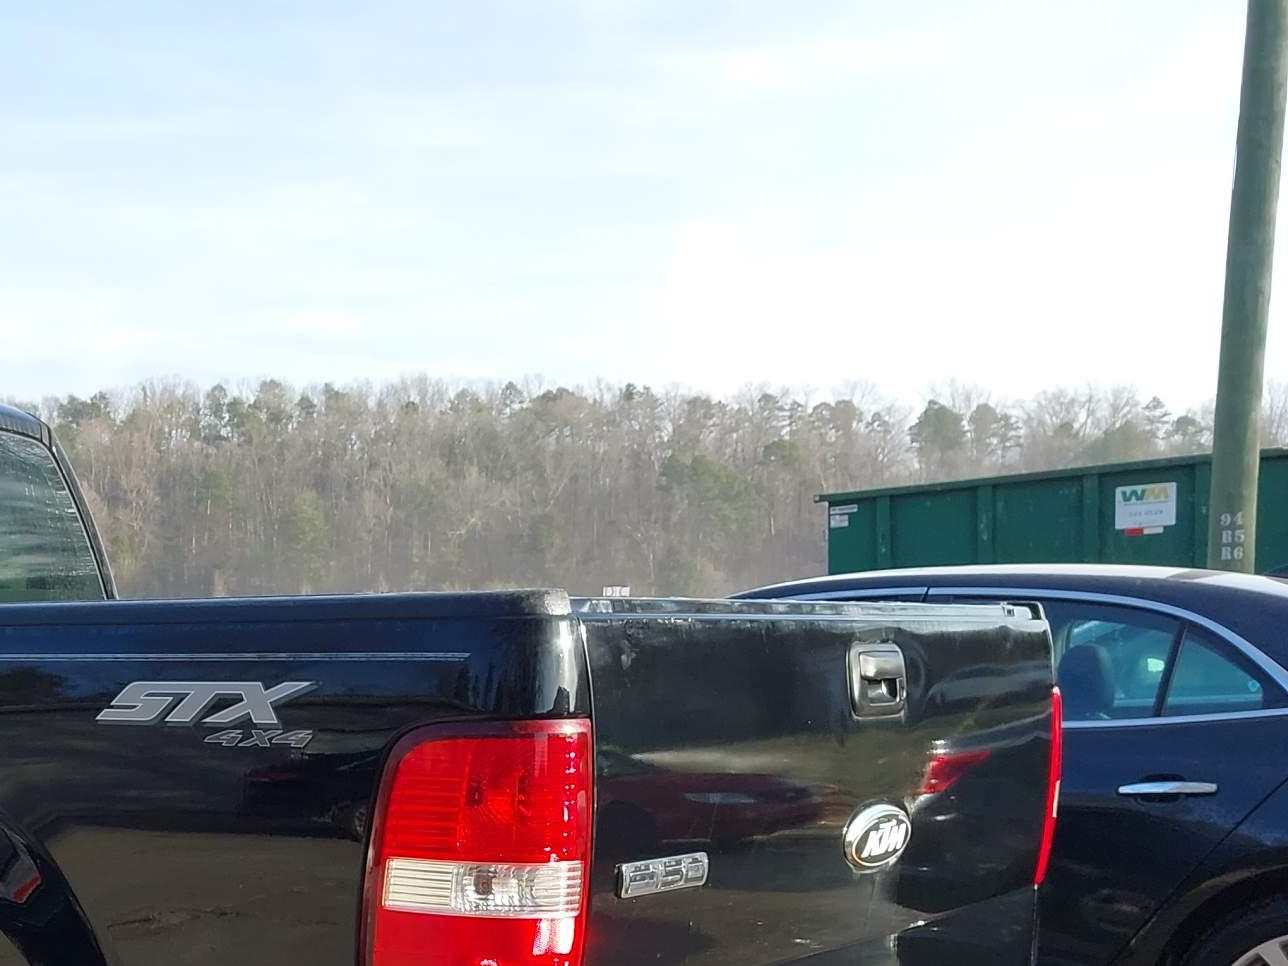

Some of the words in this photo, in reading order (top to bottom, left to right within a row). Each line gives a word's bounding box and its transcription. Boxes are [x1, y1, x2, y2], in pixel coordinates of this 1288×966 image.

[1121, 487, 1168, 502] WM
[1220, 512, 1243, 527] 94
[1221, 546, 1243, 560] R6
[96, 681, 318, 728] STX
[861, 819, 907, 858] KTM
